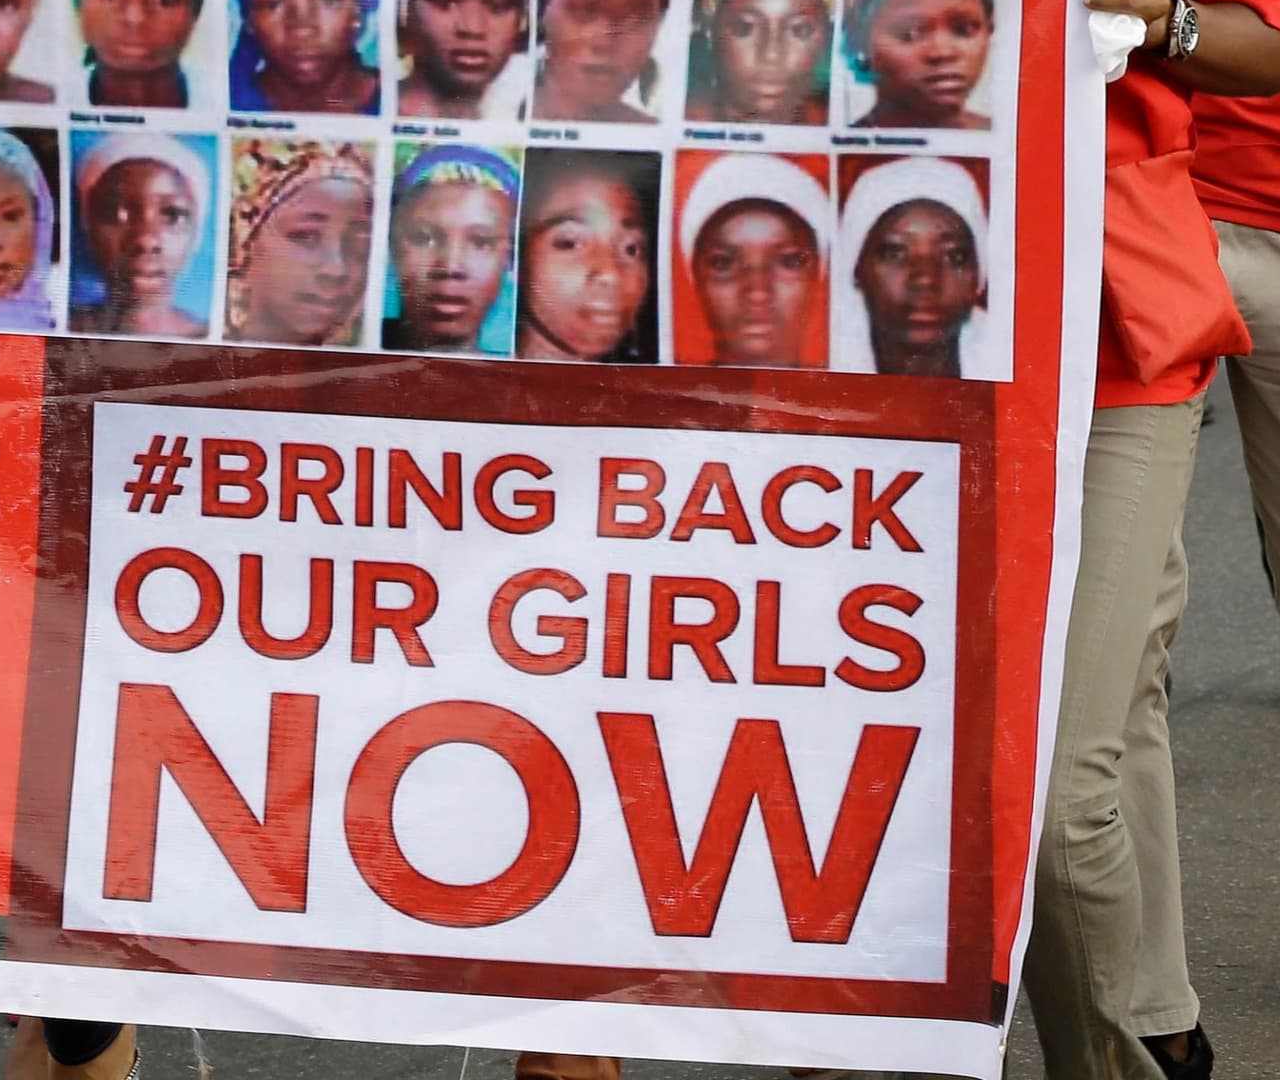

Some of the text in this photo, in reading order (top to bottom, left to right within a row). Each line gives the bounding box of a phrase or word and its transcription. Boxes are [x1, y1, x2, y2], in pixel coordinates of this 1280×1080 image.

[124, 435, 923, 551] #BRING BACK
[115, 547, 924, 690] OUR GIRLS
[102, 683, 921, 945] NOW
